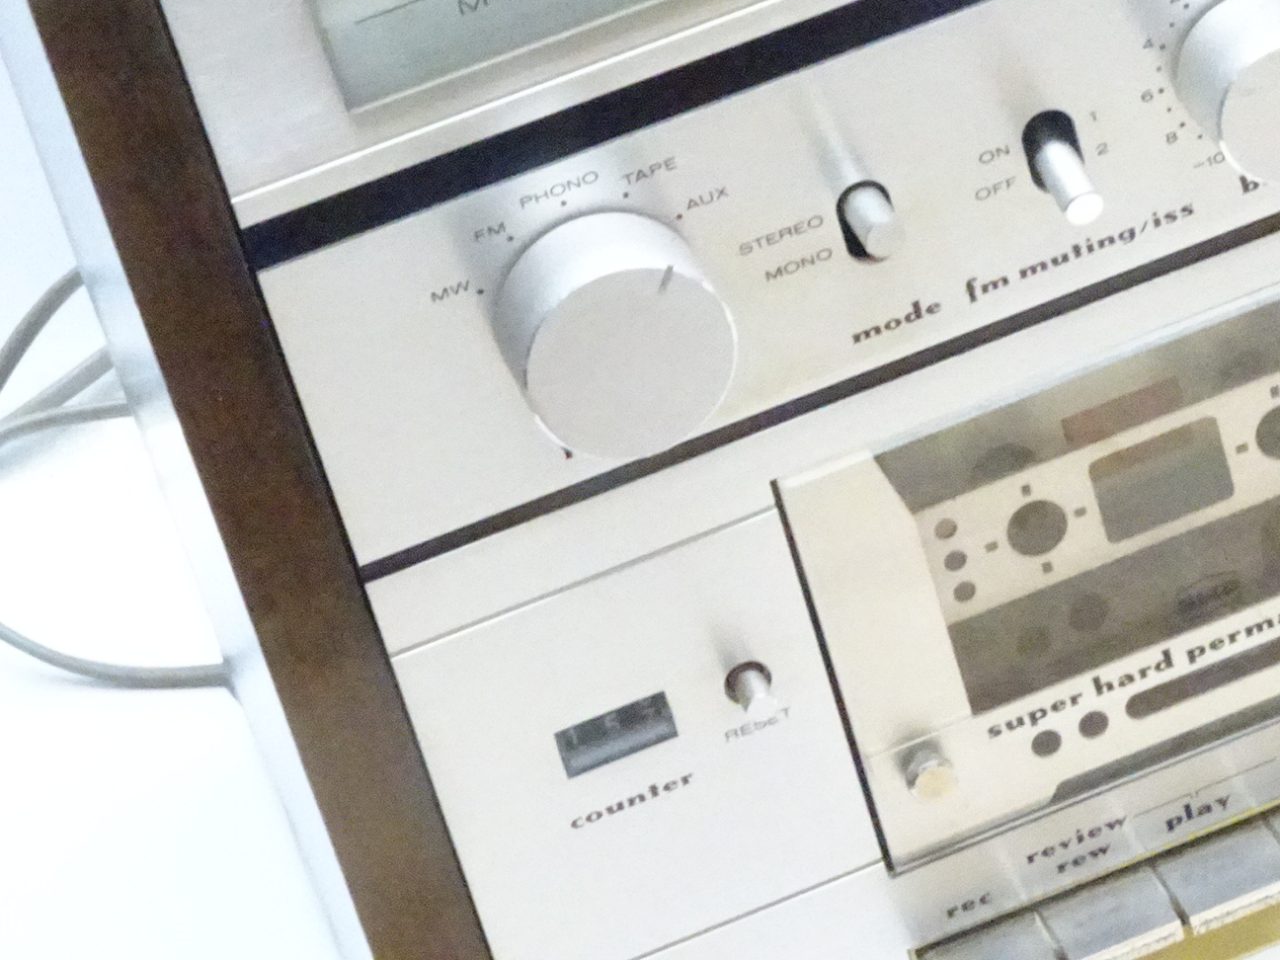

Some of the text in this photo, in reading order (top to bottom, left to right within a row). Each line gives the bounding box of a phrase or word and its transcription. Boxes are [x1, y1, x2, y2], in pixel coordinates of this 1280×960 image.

[622, 156, 679, 185] TAPE
[978, 145, 1011, 166] ON
[519, 170, 600, 210] PHONO
[686, 186, 730, 211] AUX
[974, 176, 1017, 202] OFF
[473, 222, 507, 241] FM
[738, 213, 824, 258] STEREO
[764, 247, 834, 283] MONO
[430, 280, 470, 304] MW
[964, 275, 1010, 306] fm
[852, 301, 942, 344] mode
[986, 691, 1083, 740] super
[1092, 648, 1176, 697] hard
[570, 771, 695, 830] counter
[1164, 792, 1232, 833] play
[1026, 813, 1129, 865] review
[1056, 841, 1112, 875] rew
[945, 889, 993, 920] rec
